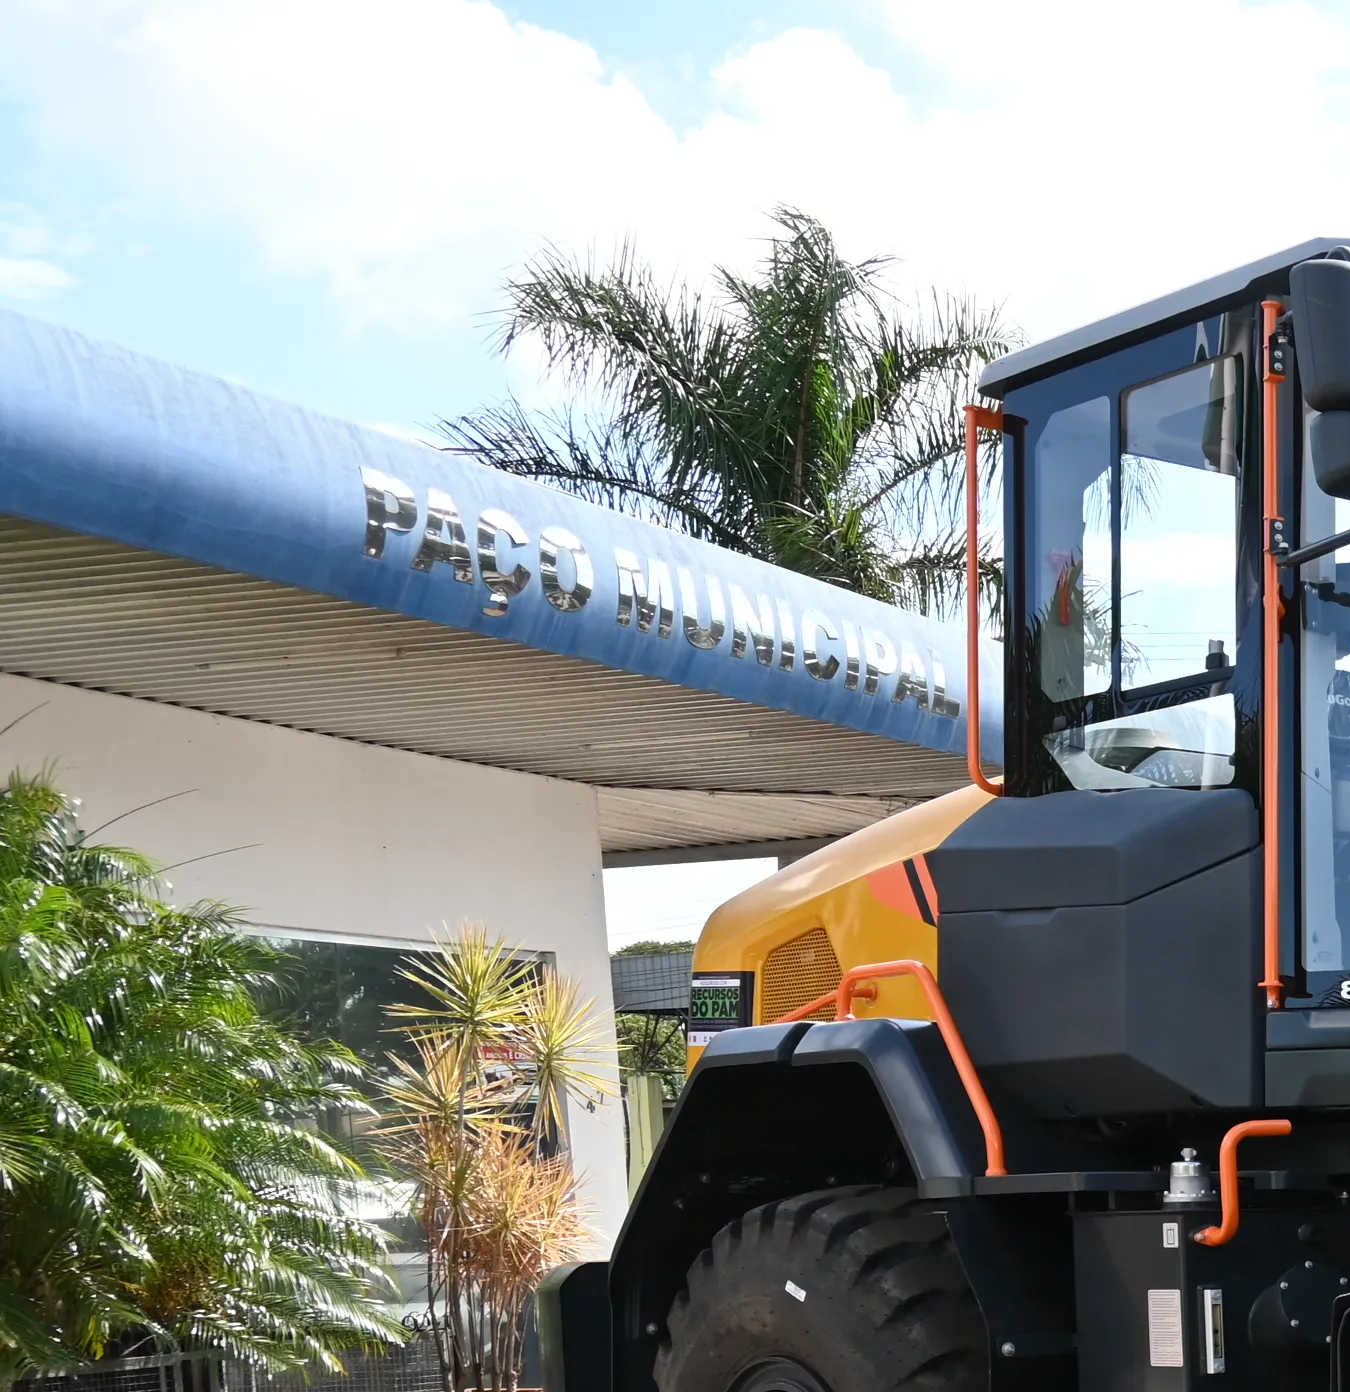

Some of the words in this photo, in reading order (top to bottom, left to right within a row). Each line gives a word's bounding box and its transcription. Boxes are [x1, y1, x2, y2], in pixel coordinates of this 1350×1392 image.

[360, 465, 594, 617] PAÇO
[614, 546, 961, 719] MUNICIPAL
[692, 988, 739, 1001] RECURSOS
[692, 1001, 709, 1017] DO
[711, 1001, 739, 1017] PAM
